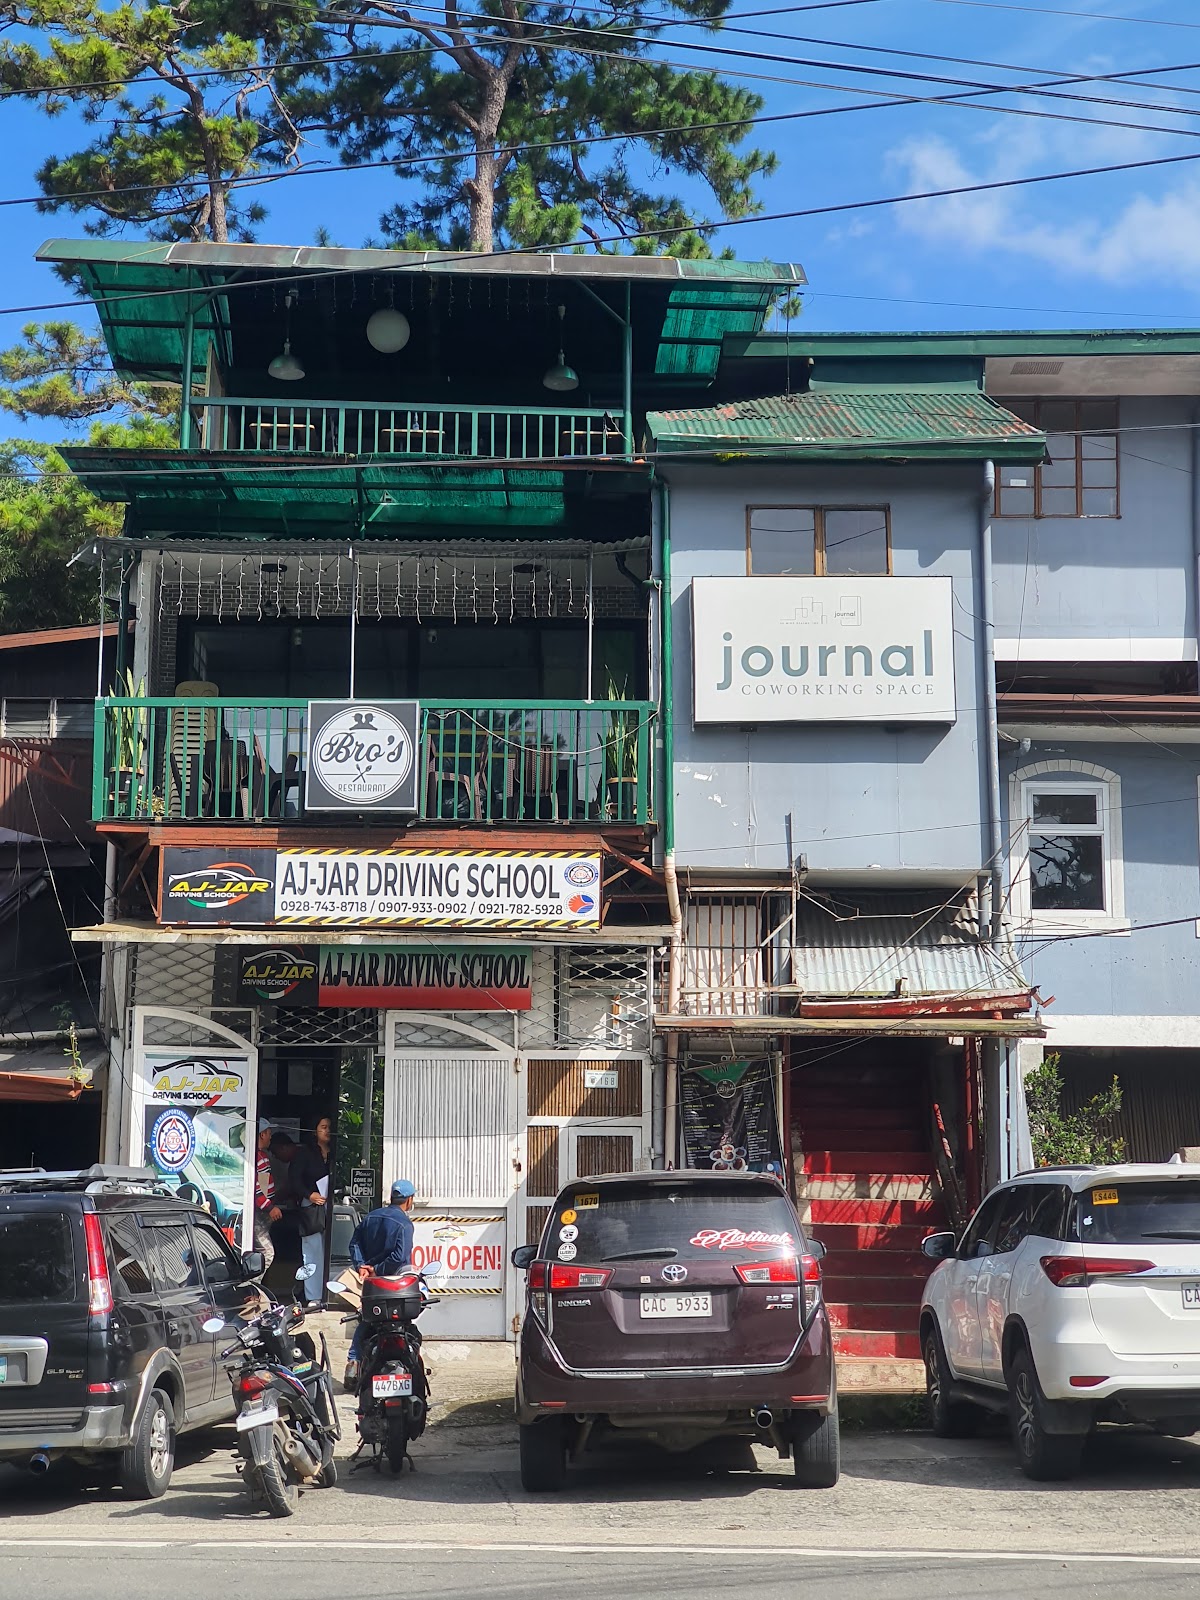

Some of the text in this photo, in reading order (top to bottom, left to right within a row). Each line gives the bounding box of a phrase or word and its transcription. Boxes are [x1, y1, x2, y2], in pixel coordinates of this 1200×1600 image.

[834, 610, 856, 619] journal
[716, 629, 934, 691] journal
[741, 683, 934, 696] COWORKING SPACE
[319, 731, 405, 763] Bro's
[338, 783, 387, 792] RESTAURANT
[280, 861, 359, 896] AJ-JAR
[367, 862, 460, 898] DRIVING
[466, 863, 560, 899] SCHOOL
[170, 881, 270, 893] AJ-JAR
[280, 900, 367, 912] 0928-743-8718
[378, 901, 467, 914] 0907-933-0902
[478, 903, 563, 915] 0921-782-5928
[243, 965, 314, 979] AJ-JAR
[321, 951, 530, 988] AJ-JAR DRIVING SCHOOL
[242, 978, 266, 986] DRIVING
[153, 1076, 240, 1092] AJ-JAR
[600, 1077, 615, 1086] 168
[152, 1091, 213, 1100] DRIVING SCHOOL
[157, 1108, 189, 1124] TRANSPORTATION
[353, 1184, 373, 1195] OPEN
[580, 1197, 598, 1206] 1670
[411, 1245, 502, 1270] OW OPEN!
[1185, 1288, 1200, 1303] CA
[557, 1299, 592, 1308] INNOVA
[642, 1297, 709, 1312] CAC 5933
[374, 1379, 410, 1391] 447BXG
